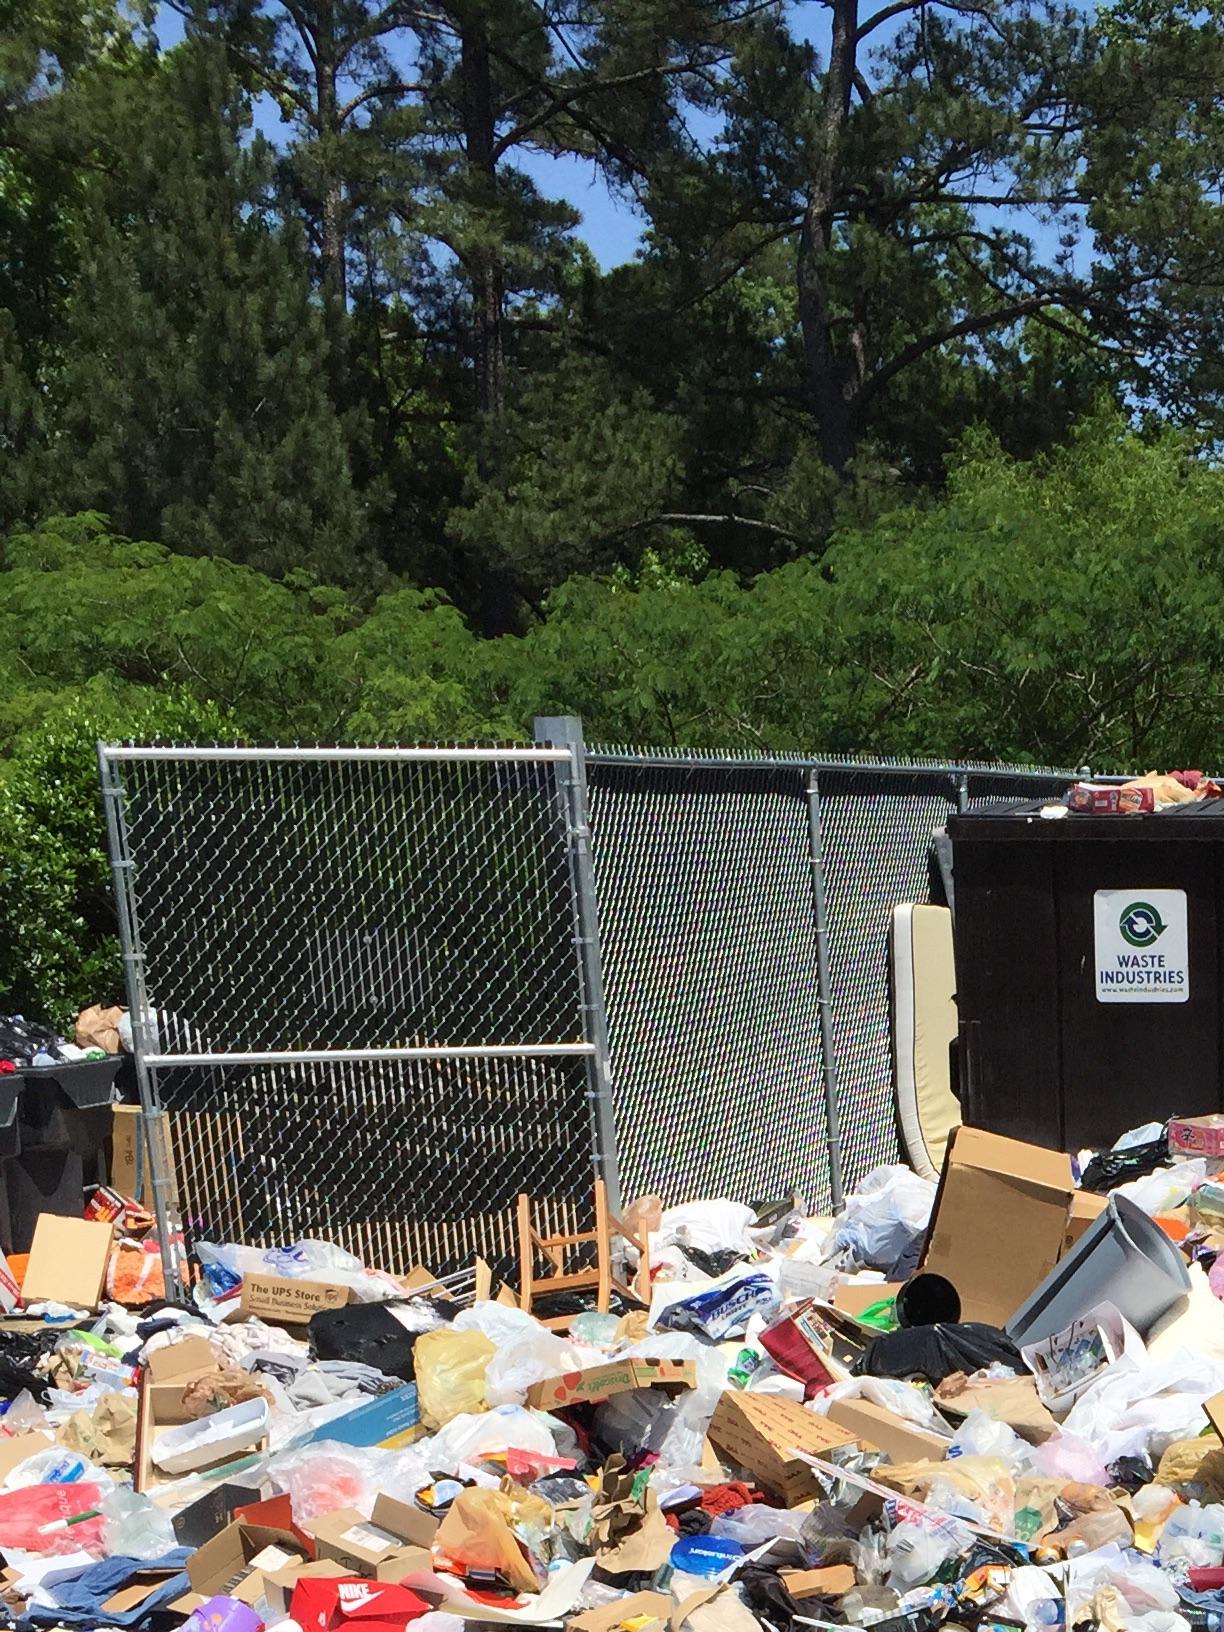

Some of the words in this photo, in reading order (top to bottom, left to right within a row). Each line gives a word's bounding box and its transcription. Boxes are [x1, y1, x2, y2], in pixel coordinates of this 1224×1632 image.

[1117, 954, 1166, 968] WASTE
[1100, 970, 1185, 984] INDUSTRIES
[251, 1283, 269, 1294] The
[272, 1286, 292, 1297] UPS
[294, 1290, 321, 1301] Store
[338, 1583, 369, 1600] NIKE
